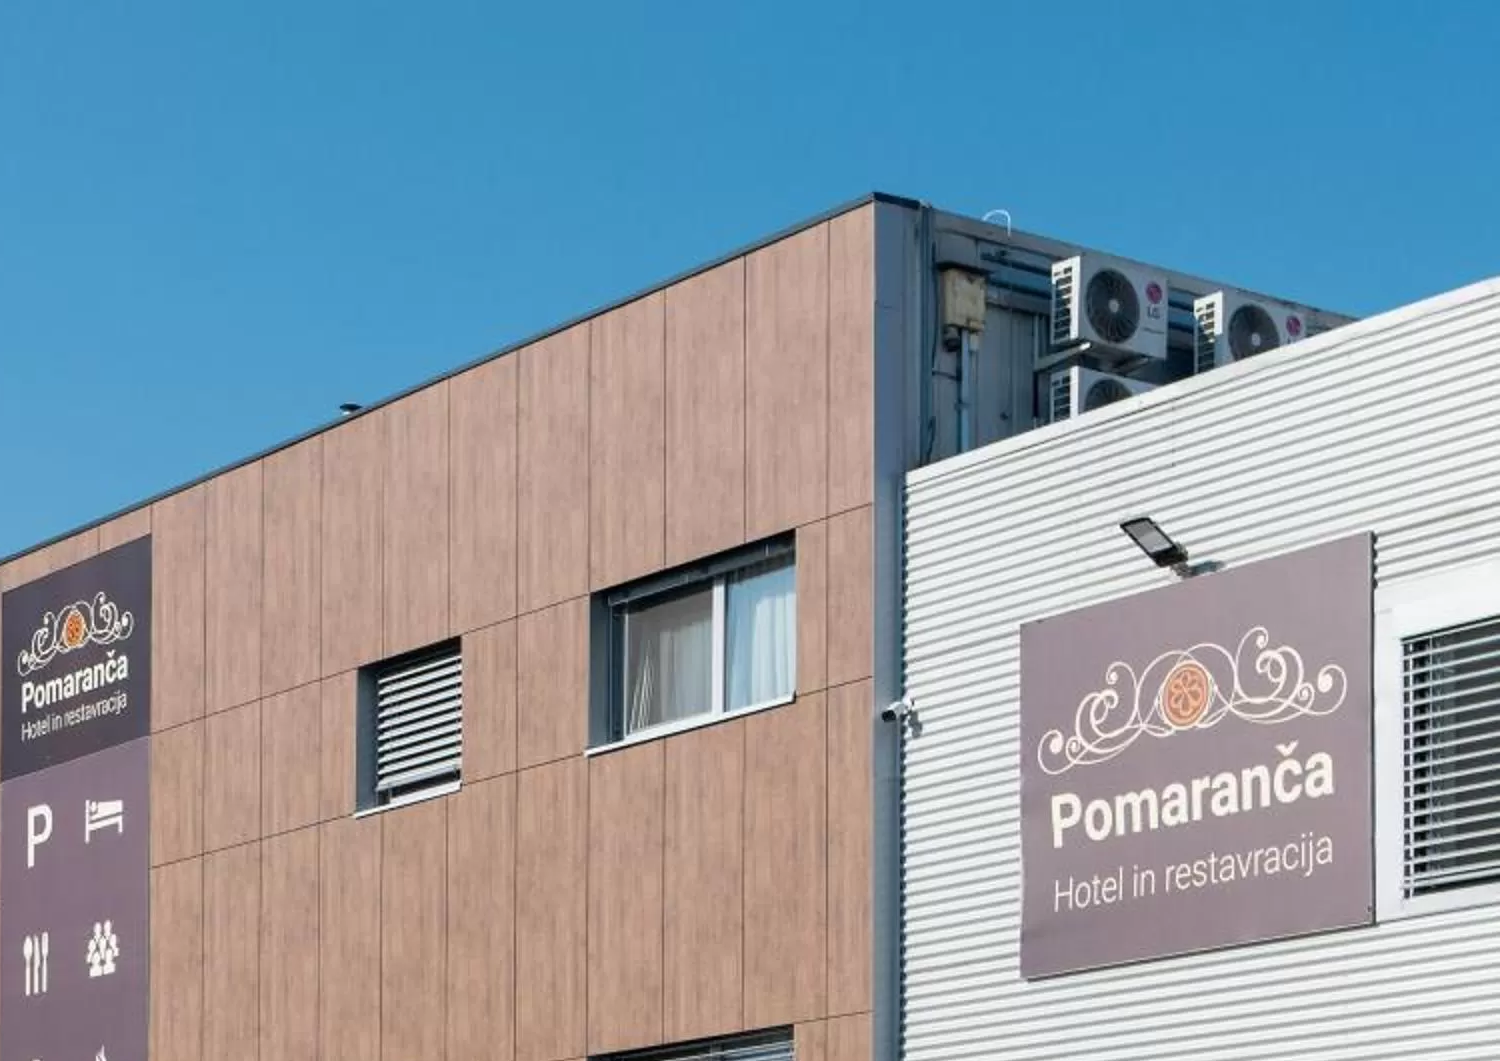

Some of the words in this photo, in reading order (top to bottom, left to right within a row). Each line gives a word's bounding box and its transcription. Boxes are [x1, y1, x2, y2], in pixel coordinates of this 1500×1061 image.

[21, 650, 129, 713] Pomaranča
[21, 713, 50, 742] Hotel
[52, 713, 64, 732] in
[64, 690, 128, 728] restavracija
[1051, 740, 1334, 848] Pomaranča
[27, 803, 53, 868] P
[1054, 867, 1123, 913] Hotel
[1133, 864, 1156, 897] in
[1165, 833, 1334, 894] restavracija
